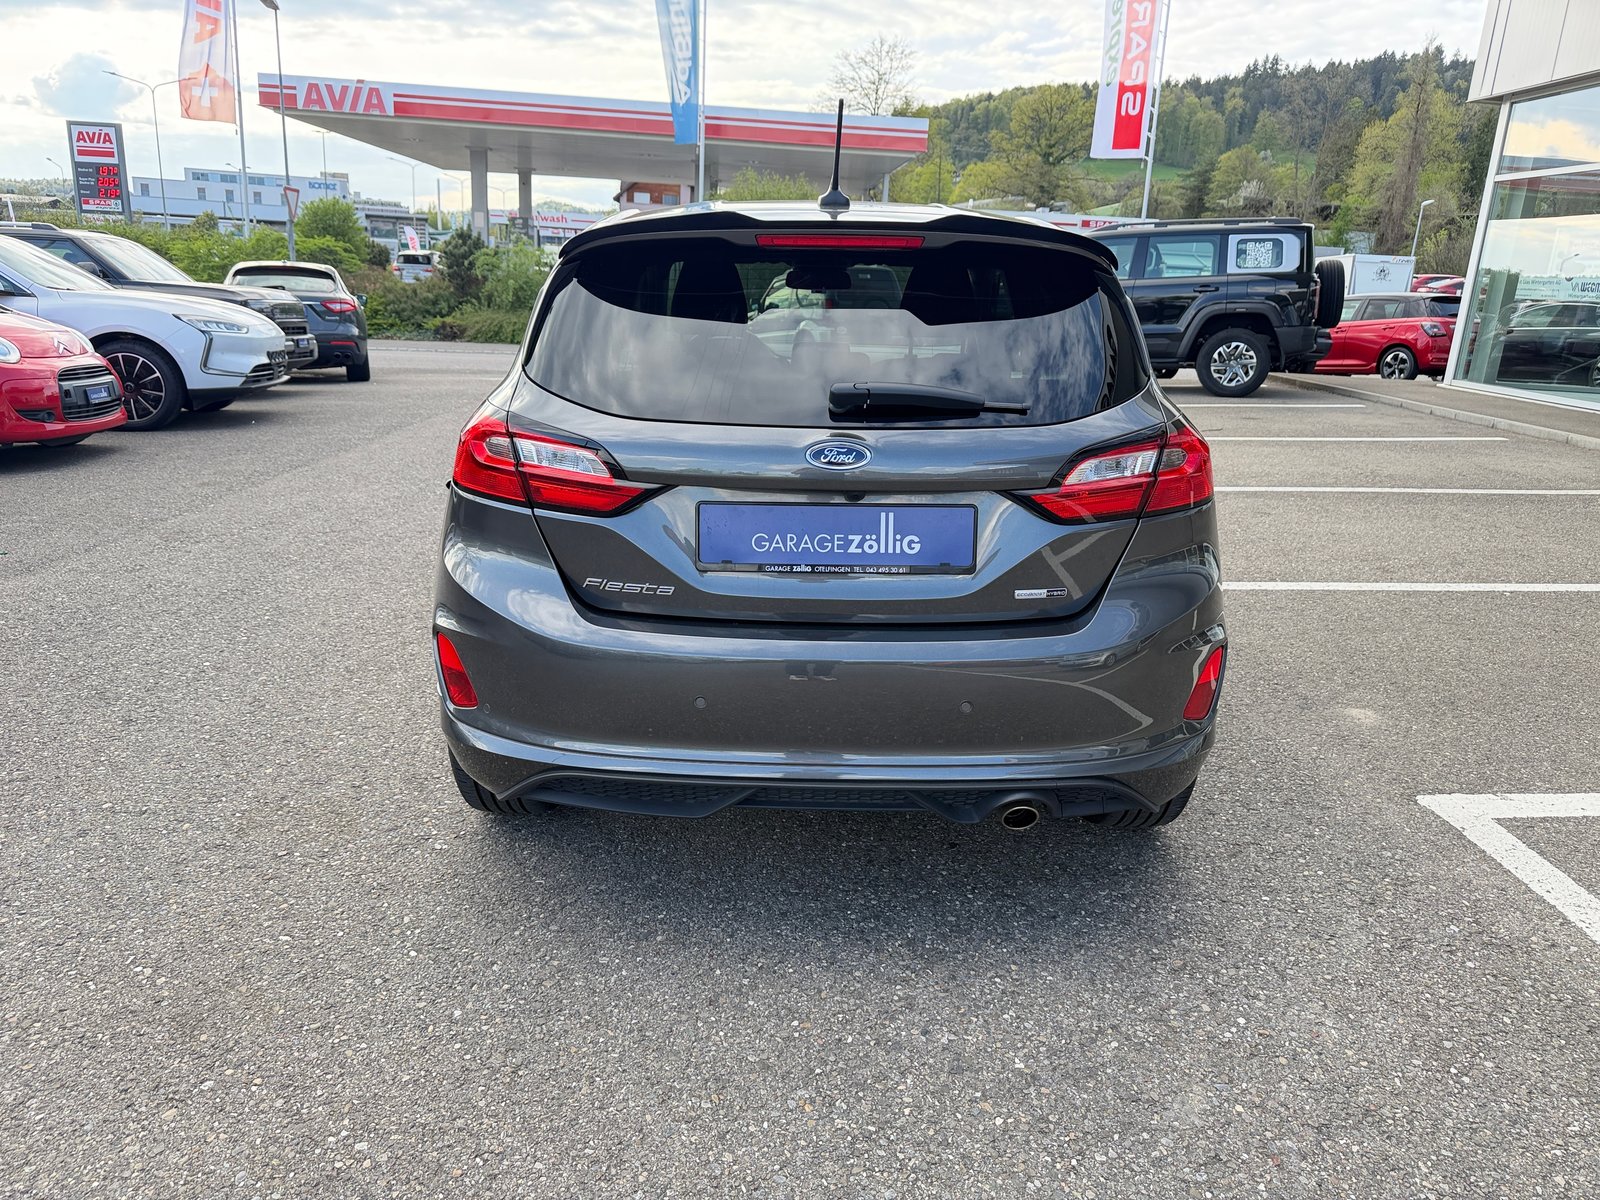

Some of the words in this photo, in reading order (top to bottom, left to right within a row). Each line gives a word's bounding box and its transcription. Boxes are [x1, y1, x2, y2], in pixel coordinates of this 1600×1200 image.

[302, 79, 388, 115] AVIA
[76, 128, 113, 145] AVIA
[820, 447, 857, 463] Ford
[751, 533, 844, 553] GARAGE
